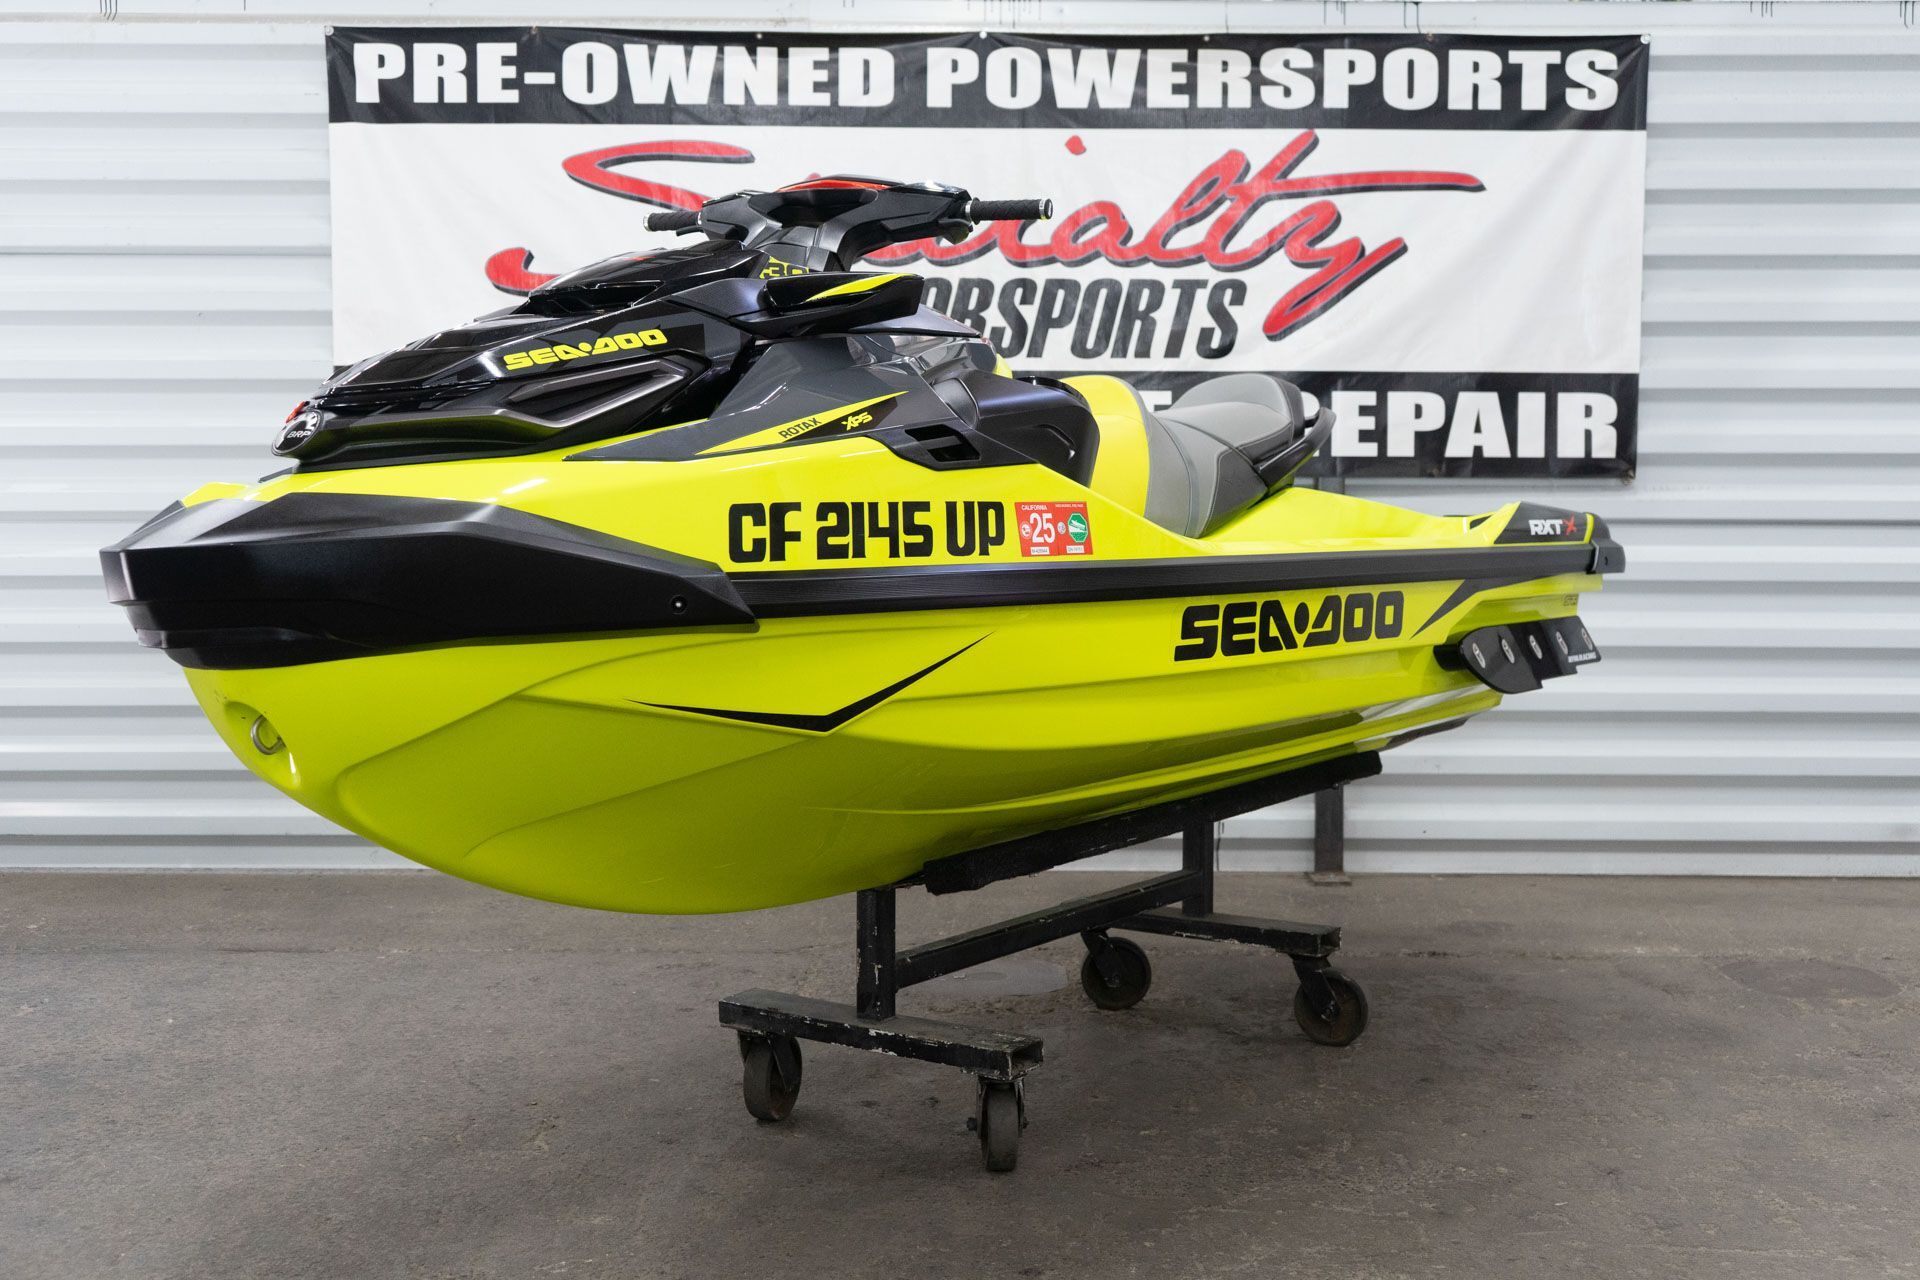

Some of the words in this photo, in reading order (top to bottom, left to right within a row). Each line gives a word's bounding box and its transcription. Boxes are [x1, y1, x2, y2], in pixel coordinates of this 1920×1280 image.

[353, 42, 895, 108] PRE-OWNED
[926, 47, 1619, 112] POWERSPORTS
[286, 430, 311, 439] BRP
[778, 417, 822, 439] ROTAX
[841, 411, 873, 431] XPS
[728, 501, 802, 563] CF
[816, 501, 934, 560] 2145
[945, 500, 1005, 557] UP
[1030, 512, 1057, 544] 25
